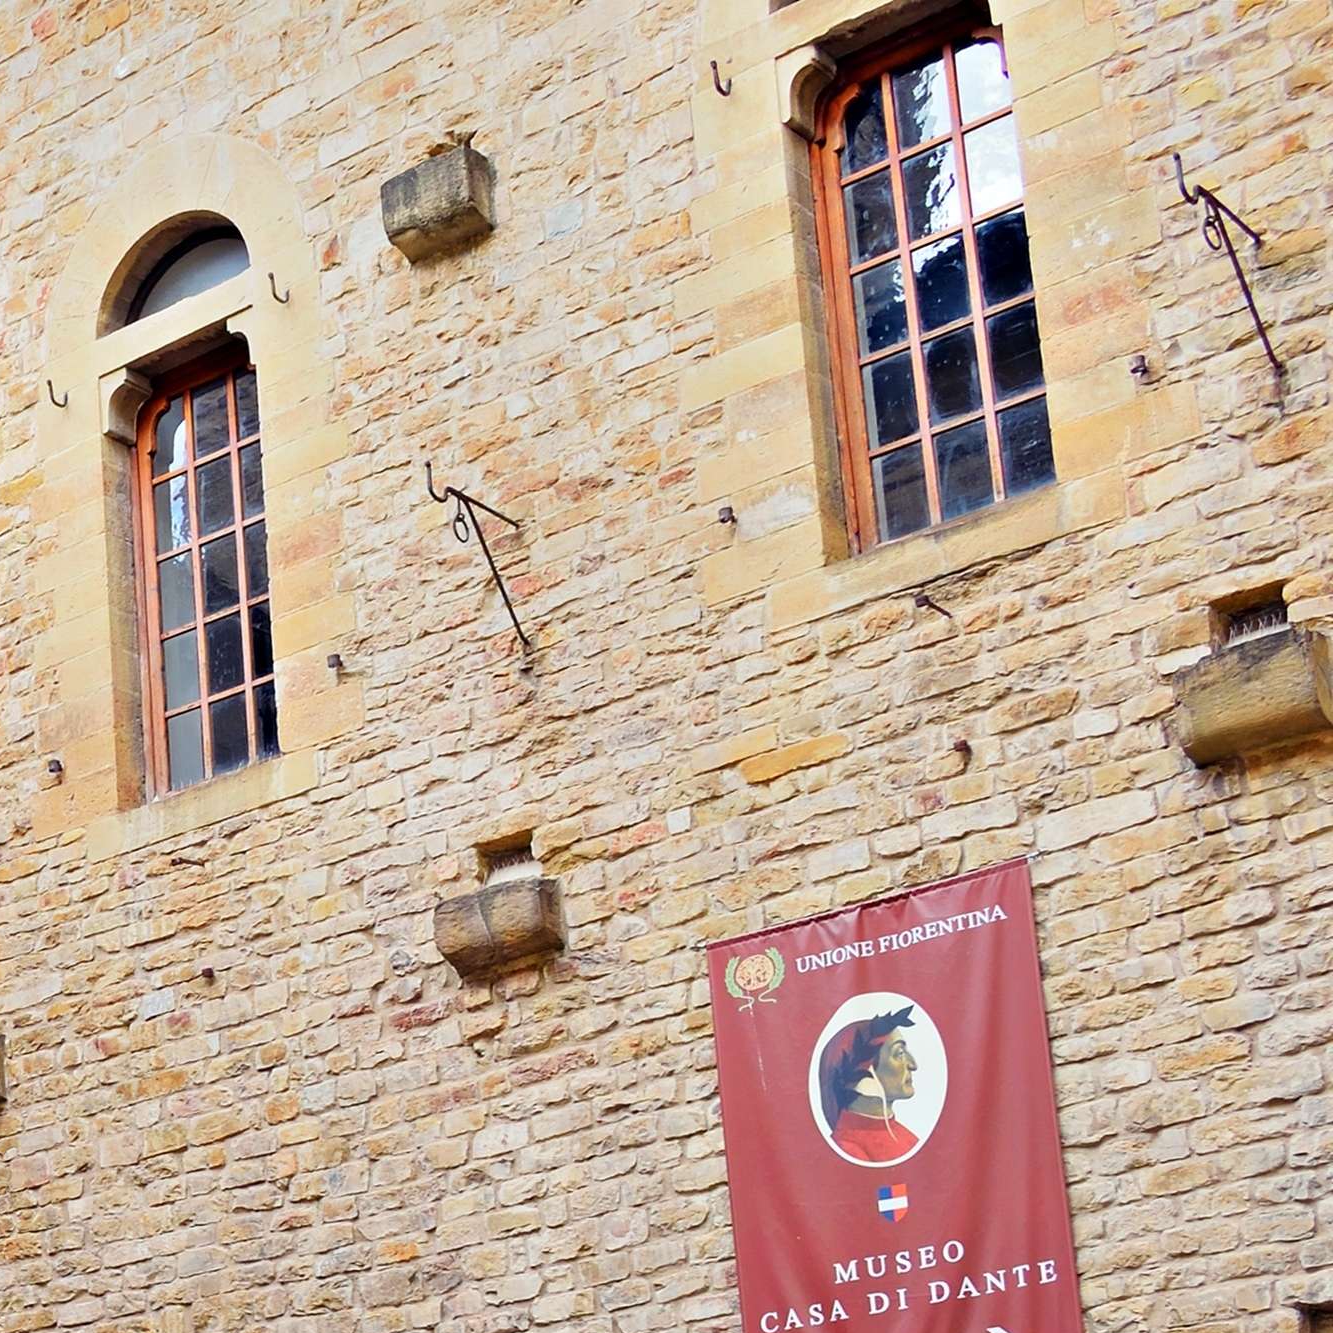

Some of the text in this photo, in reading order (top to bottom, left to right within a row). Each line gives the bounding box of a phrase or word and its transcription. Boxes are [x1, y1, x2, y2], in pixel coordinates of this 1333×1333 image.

[795, 903, 1008, 974] UNIONE FIORENTINA
[832, 1239, 966, 1285] MUSEO
[868, 1289, 910, 1316] DI
[928, 1258, 1059, 1305] DANTE
